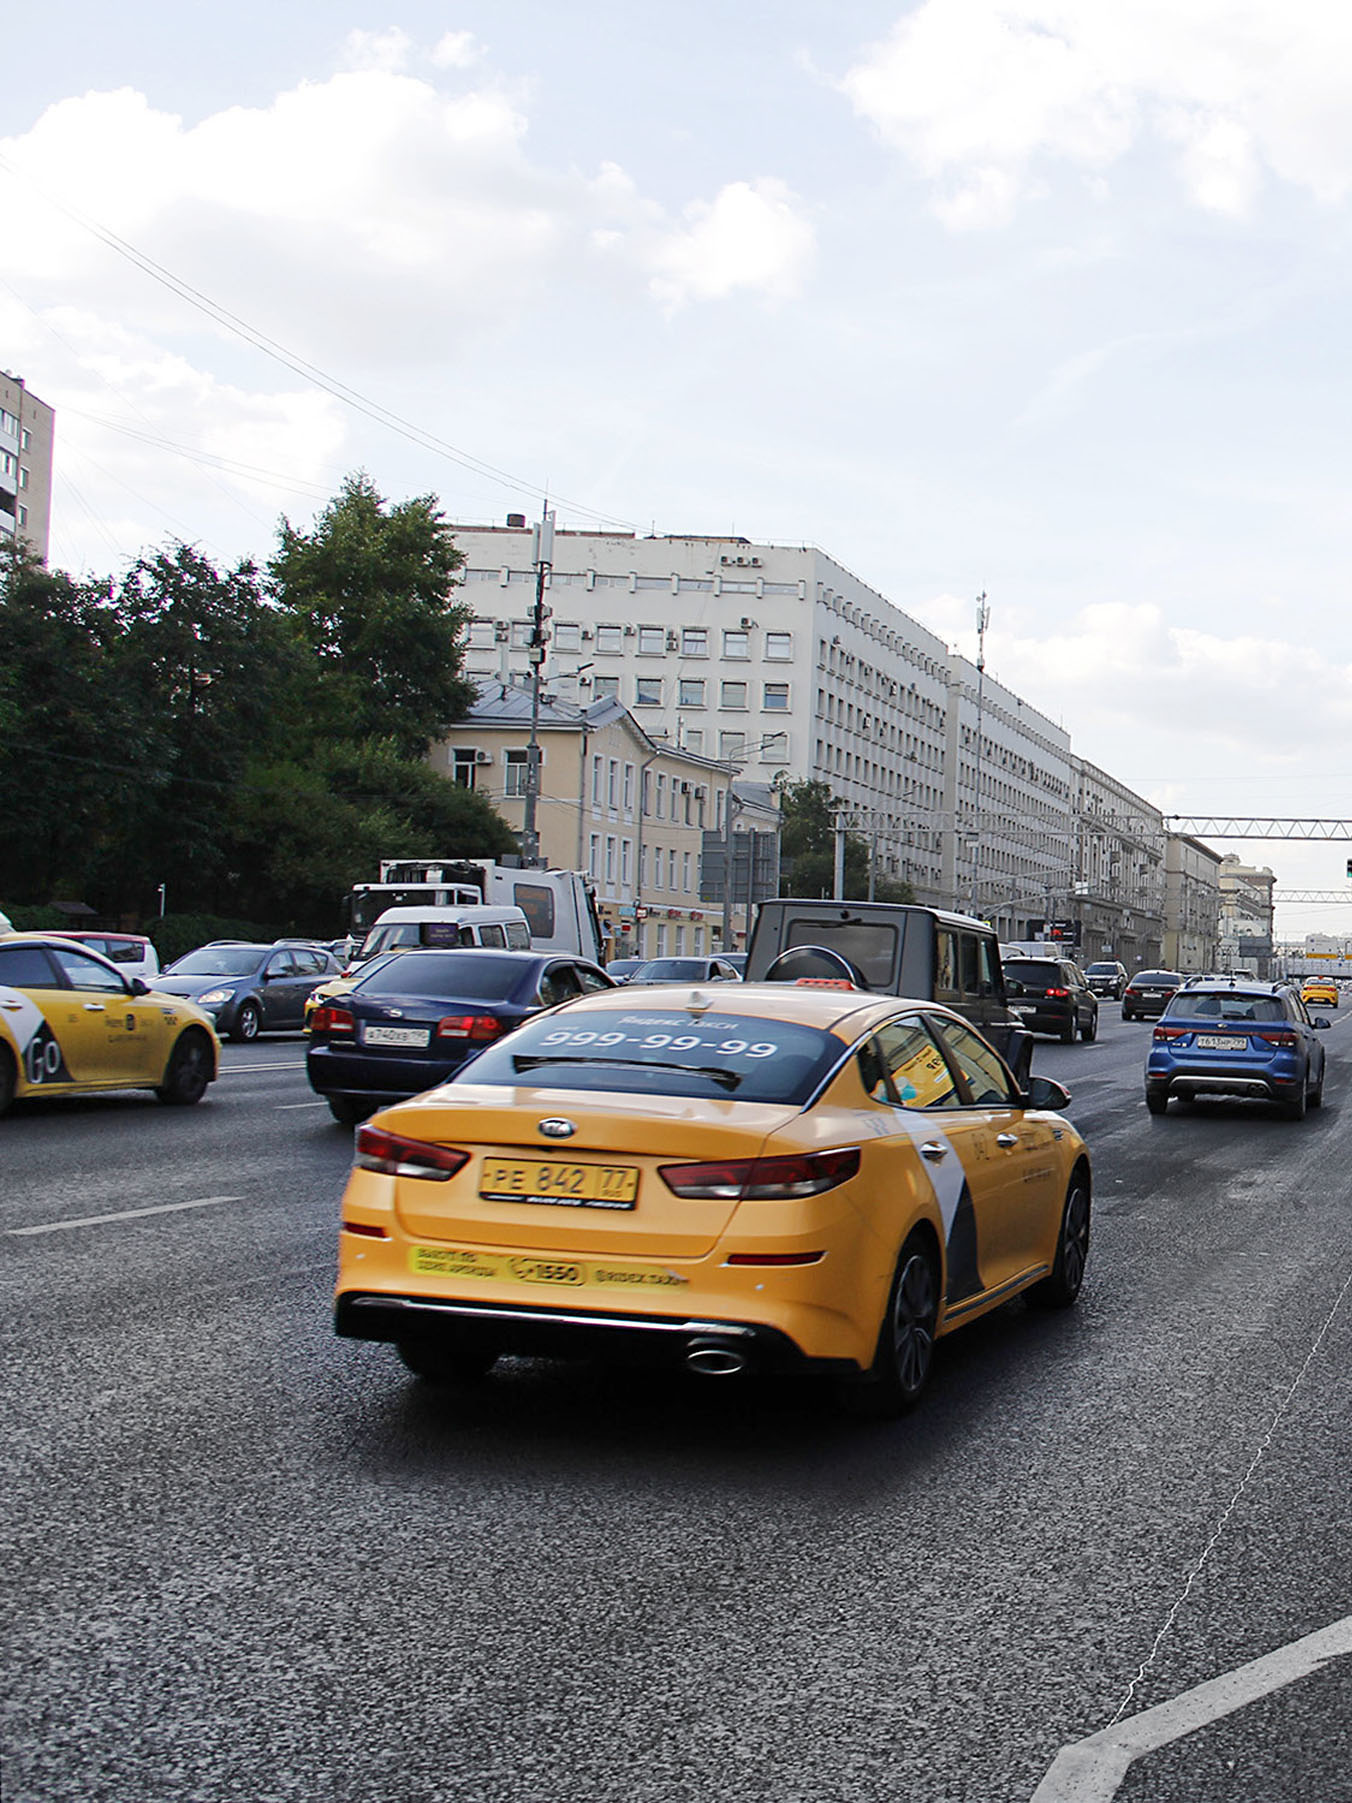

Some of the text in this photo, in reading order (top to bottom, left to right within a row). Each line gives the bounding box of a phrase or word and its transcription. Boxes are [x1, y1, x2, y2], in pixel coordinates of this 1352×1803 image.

[539, 1031, 778, 1059] 999-99-99
[538, 1166, 586, 1194] 842
[602, 1169, 628, 1189] 77
